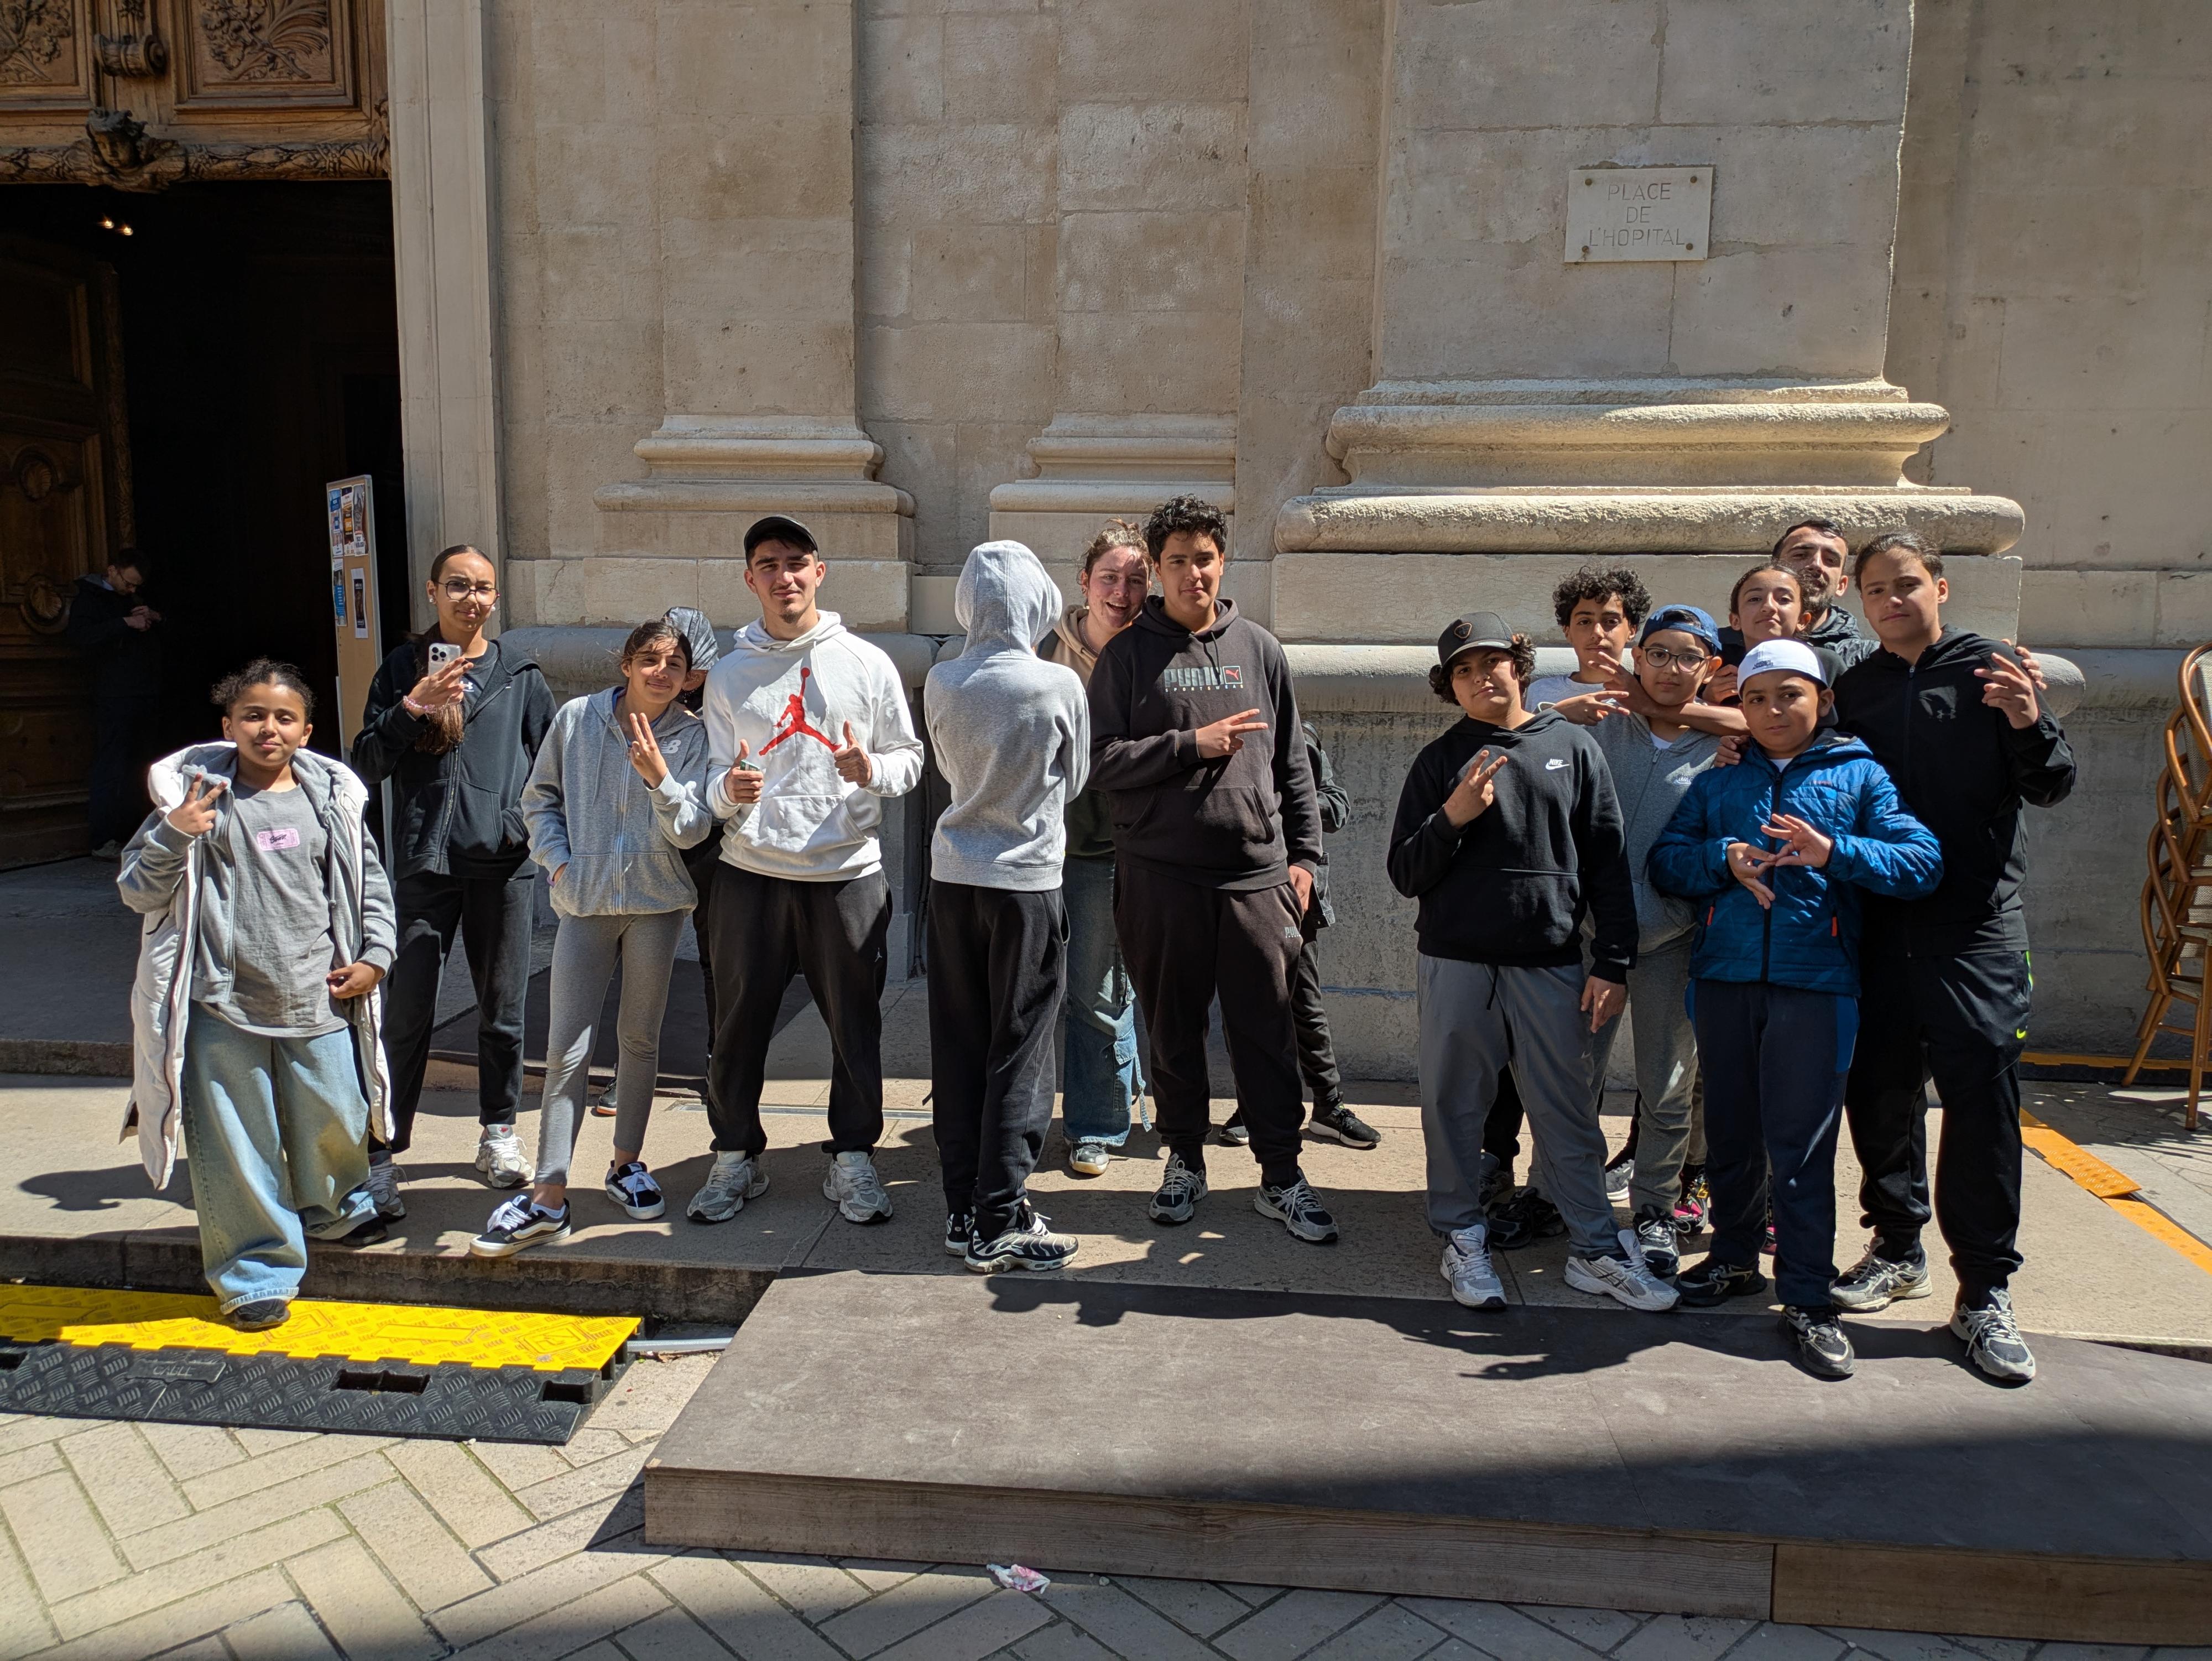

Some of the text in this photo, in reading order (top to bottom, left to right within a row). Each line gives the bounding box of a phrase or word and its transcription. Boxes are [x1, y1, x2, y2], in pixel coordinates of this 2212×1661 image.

[1608, 183, 1671, 201] PLACE
[1626, 206, 1652, 223] DE
[1589, 228, 1685, 247] L'HOPITAL
[1164, 667, 1224, 688] PUMA
[153, 1366, 195, 1376] CABLE
